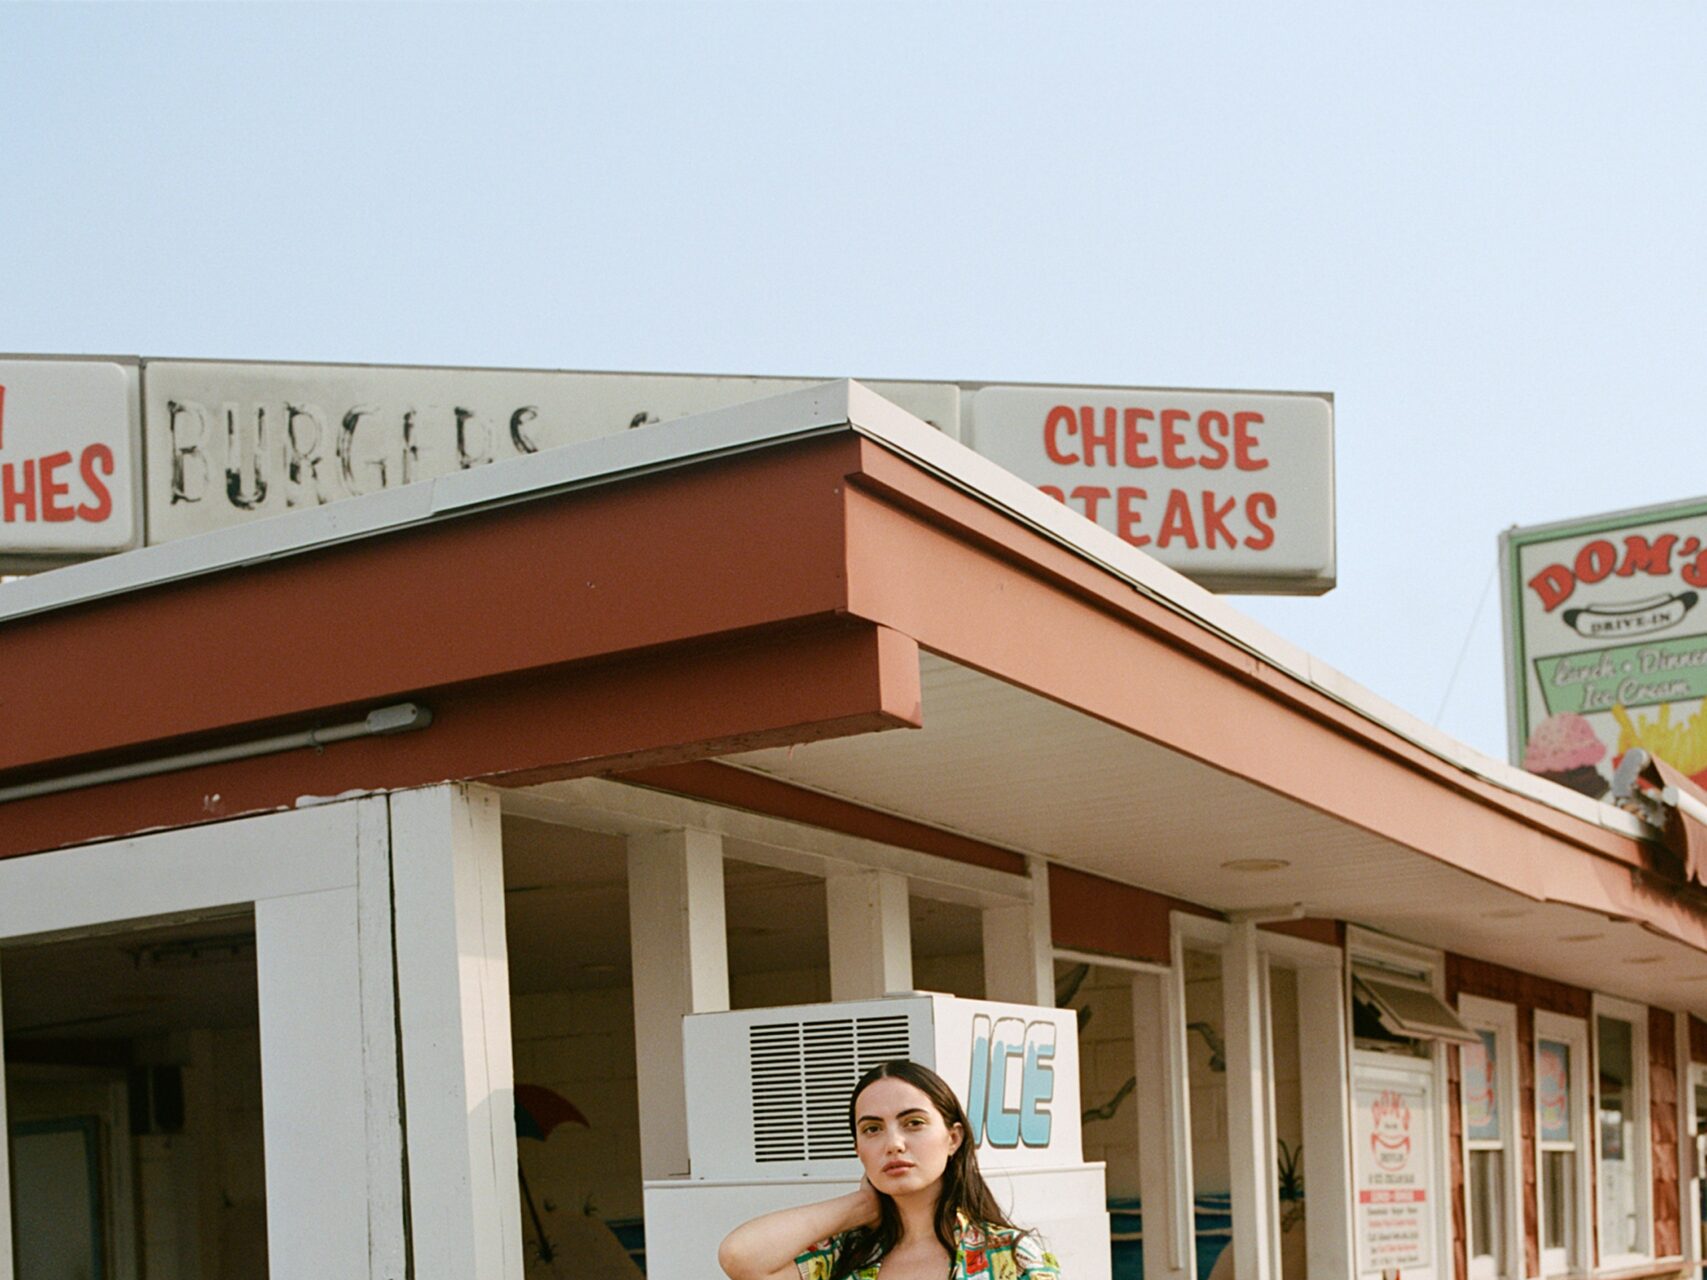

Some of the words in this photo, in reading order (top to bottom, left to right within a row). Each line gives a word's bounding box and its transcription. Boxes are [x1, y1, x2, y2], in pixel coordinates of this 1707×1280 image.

[1043, 405, 1270, 472] CHEESE
[1580, 683, 1614, 709] Ice
[1617, 676, 1691, 705] Cream
[967, 1013, 1057, 1149] ICE
